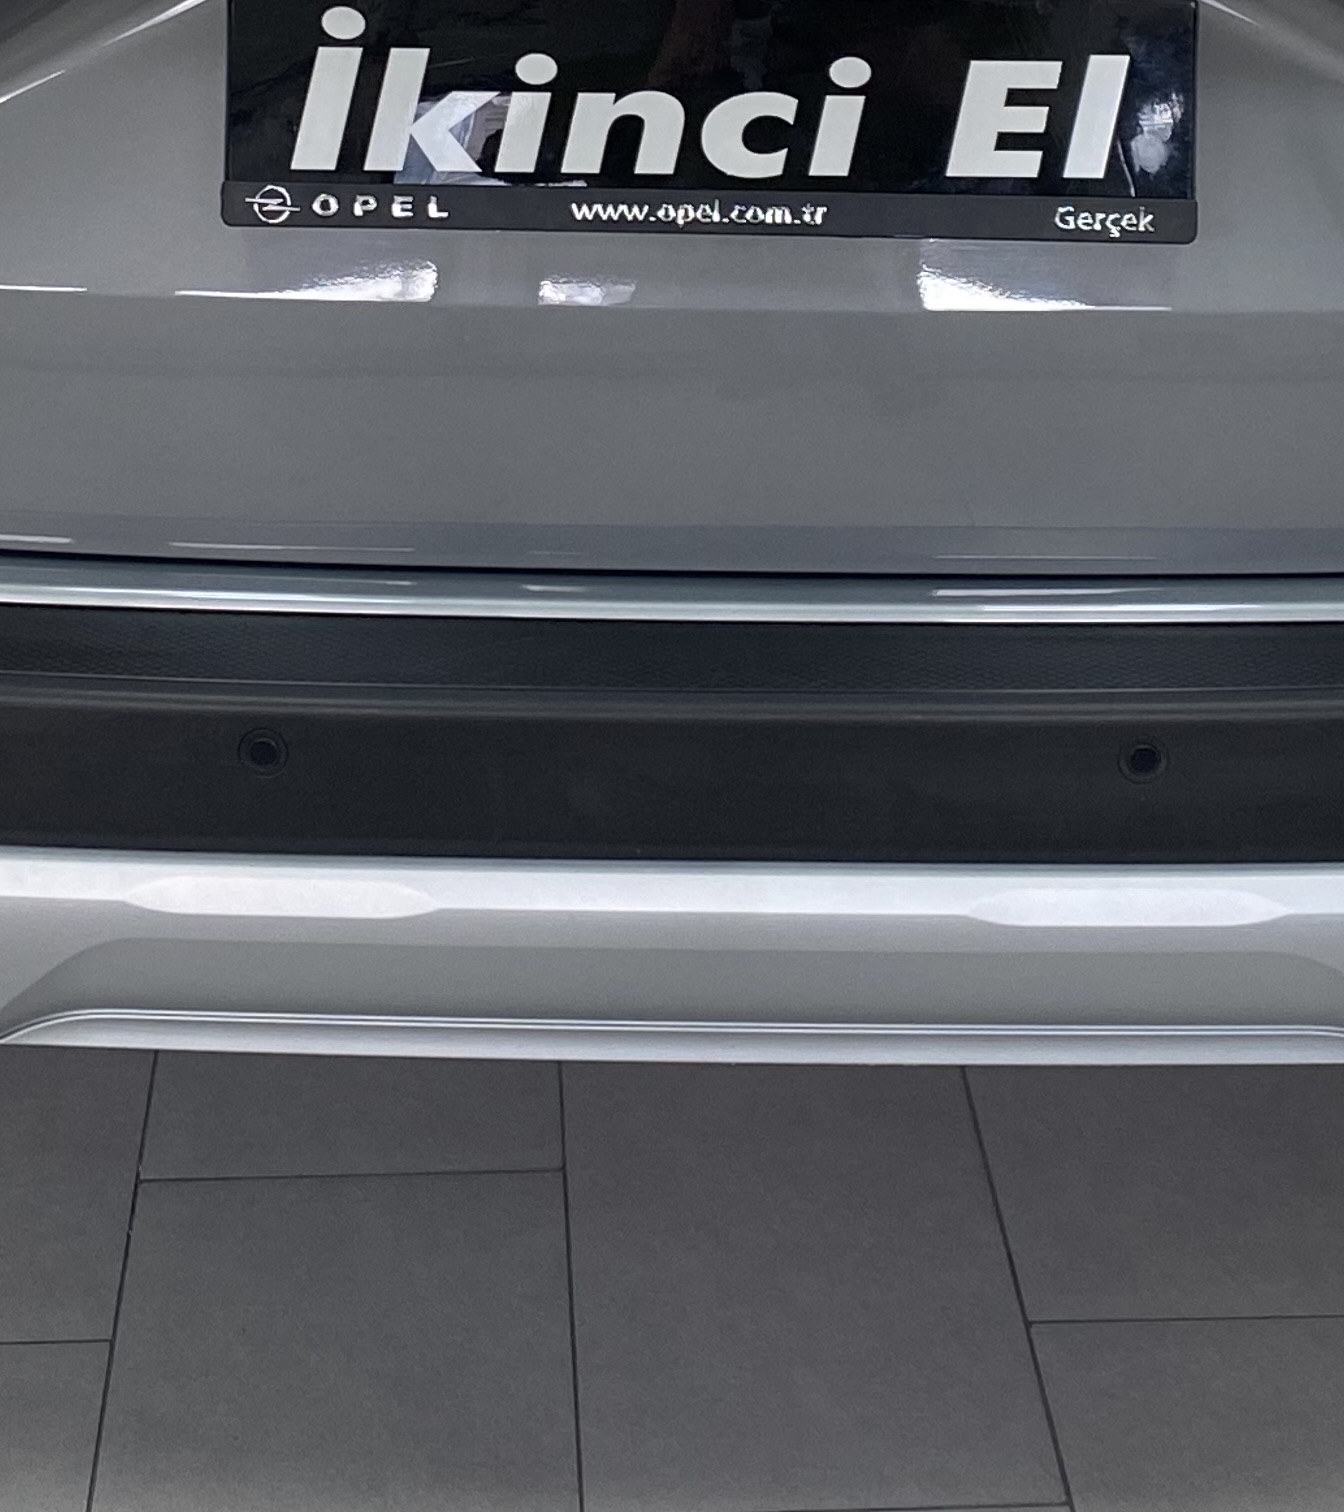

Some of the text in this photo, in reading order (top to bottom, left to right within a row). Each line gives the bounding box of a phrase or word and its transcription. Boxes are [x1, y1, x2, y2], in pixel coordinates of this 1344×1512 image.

[290, 6, 1130, 179] İkinci El
[312, 193, 449, 218] OPEL
[571, 199, 827, 228] www.opel.com.tr
[1054, 206, 1155, 237] Gerçek
